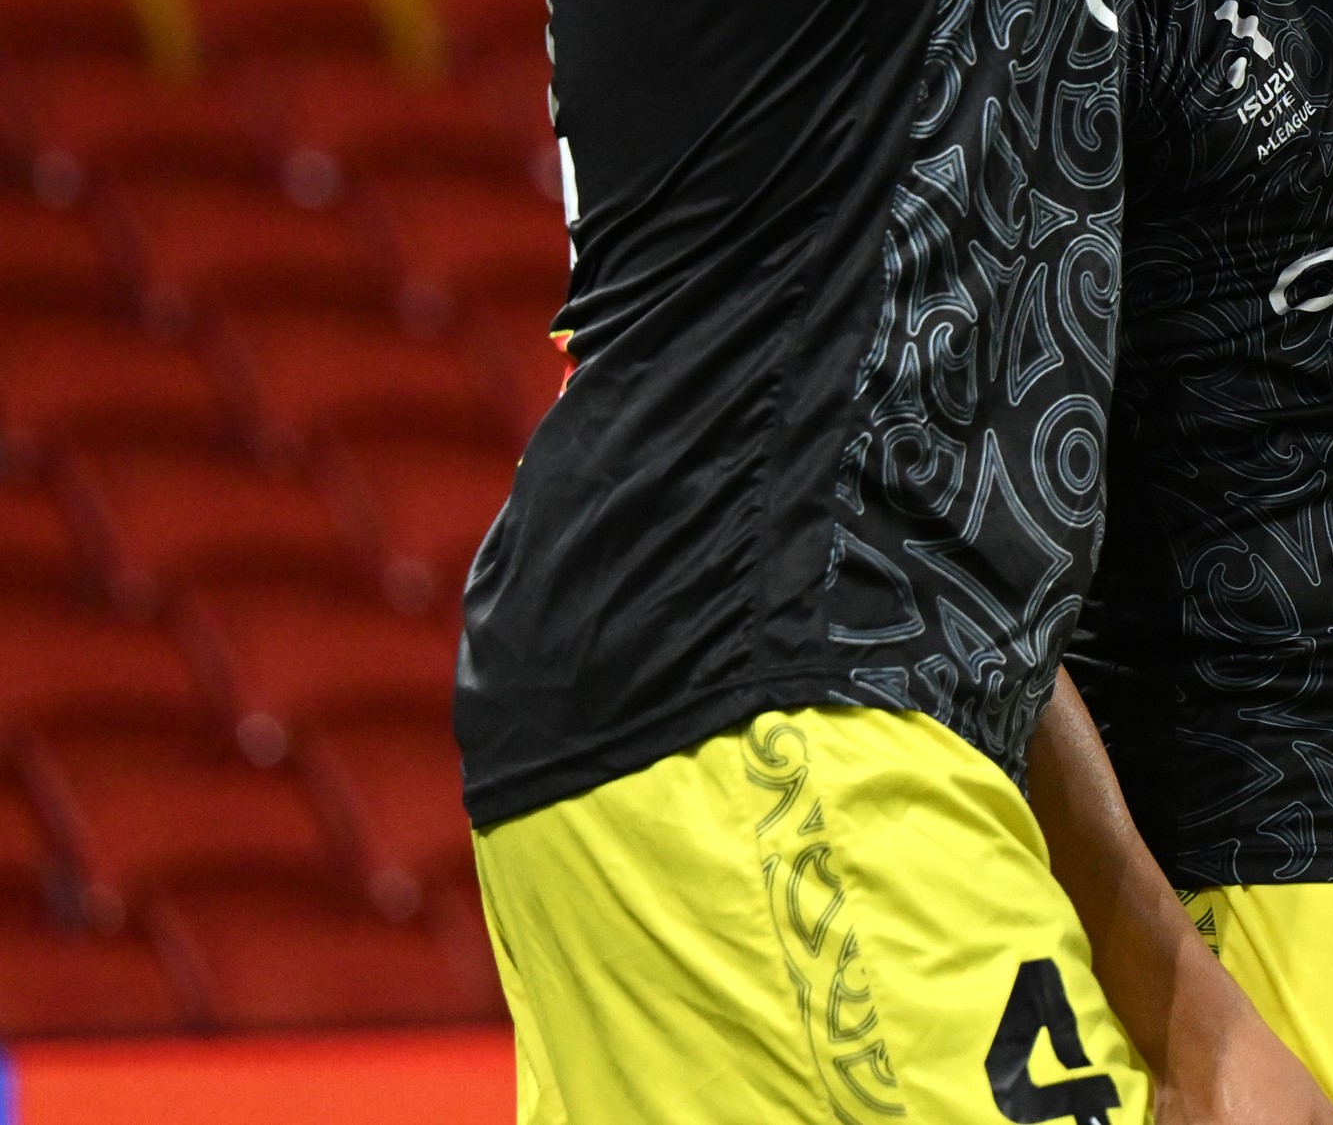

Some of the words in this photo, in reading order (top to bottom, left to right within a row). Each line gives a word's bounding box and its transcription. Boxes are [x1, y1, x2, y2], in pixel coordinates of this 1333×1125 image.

[1237, 61, 1295, 124] ISUZU
[1260, 90, 1296, 127] UTE
[1256, 100, 1318, 160] A-LEAGUE
[984, 957, 1122, 1125] 4
